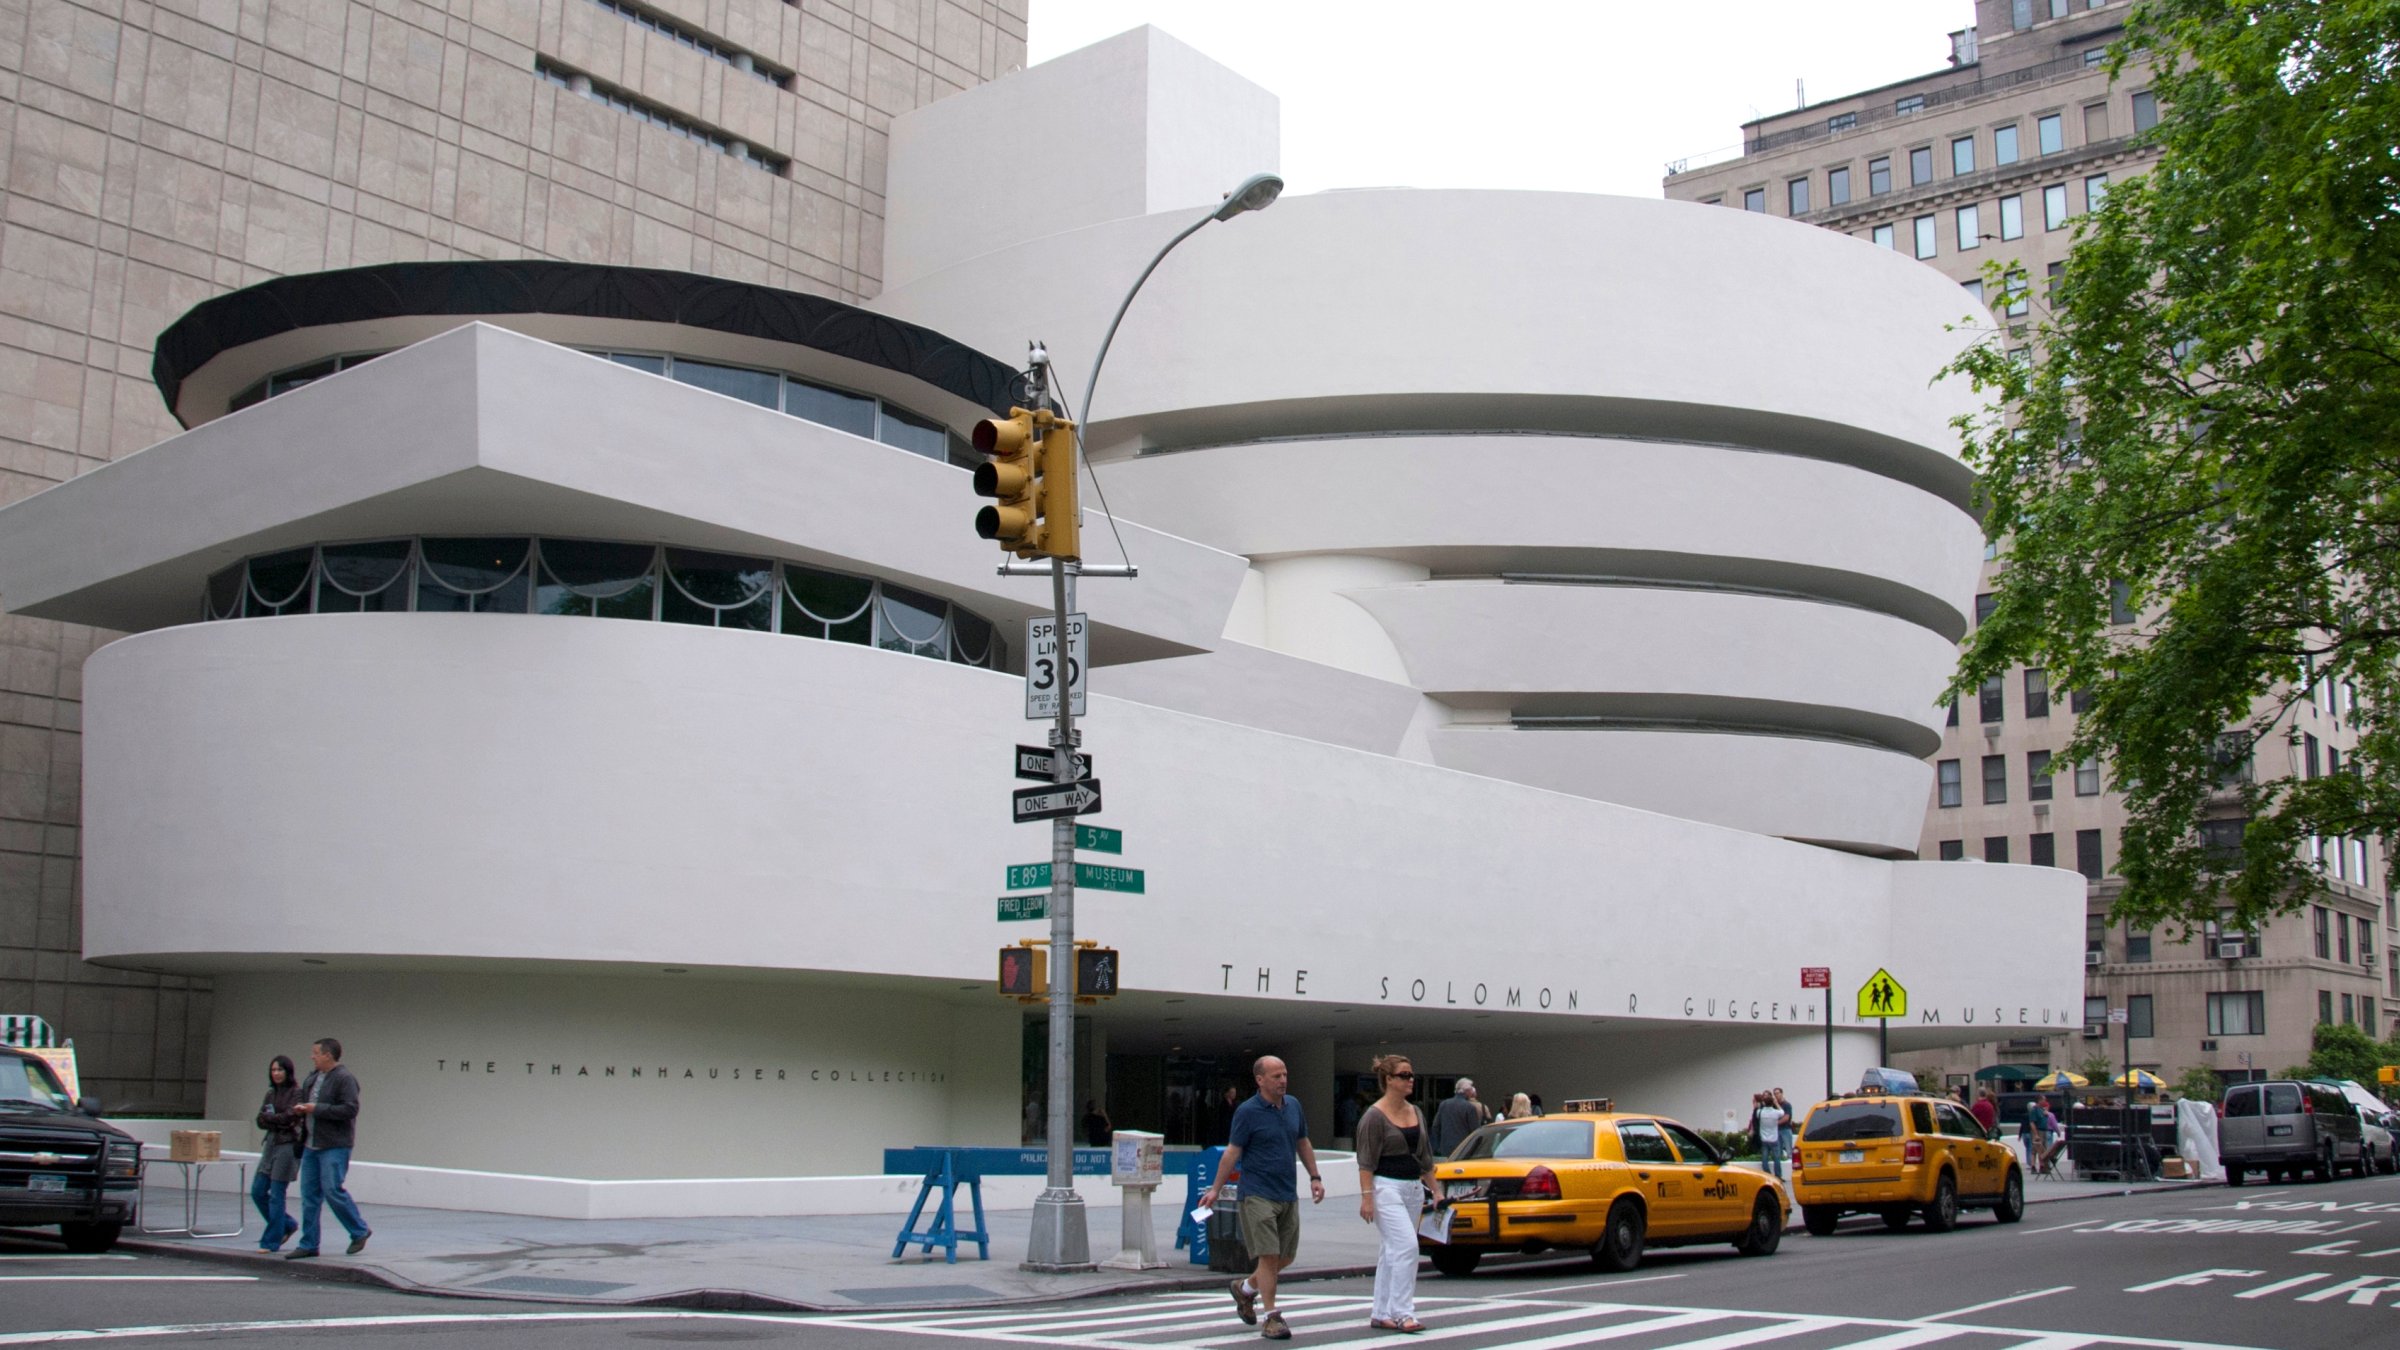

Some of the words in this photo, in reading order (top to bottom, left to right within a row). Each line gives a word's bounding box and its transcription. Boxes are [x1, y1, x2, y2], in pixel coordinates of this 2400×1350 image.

[1038, 640, 1076, 655] LIMT
[1033, 657, 1080, 690] 30
[1030, 694, 1051, 703] SPEED
[1054, 691, 1083, 701] CKED
[1038, 702, 1049, 710] BY
[1052, 701, 1073, 709] RAR
[1027, 756, 1049, 772] ONE
[1025, 796, 1049, 812] ONE
[1065, 790, 1090, 806] WAY
[1088, 828, 1097, 848] 5
[1099, 830, 1109, 841] AV
[1010, 867, 1018, 887] E
[1022, 866, 1037, 886] 89
[1039, 865, 1048, 876] ST
[1085, 866, 1134, 884] MUSEUM
[1000, 898, 1021, 912] FRED
[1022, 896, 1043, 911] LEBOW
[1222, 964, 1308, 994] THE
[1381, 976, 1578, 1010] SOLOMON
[1629, 993, 1638, 1013] R
[1684, 997, 1867, 1024] GUGGENHI
[1922, 1007, 2069, 1024] MUSEUM
[437, 1060, 495, 1073] THE
[526, 1063, 786, 1081] THANNHAUSER
[1075, 1154, 1087, 1164] DO
[1090, 1154, 1106, 1164] NOT
[2122, 1268, 2400, 1307] FIR
